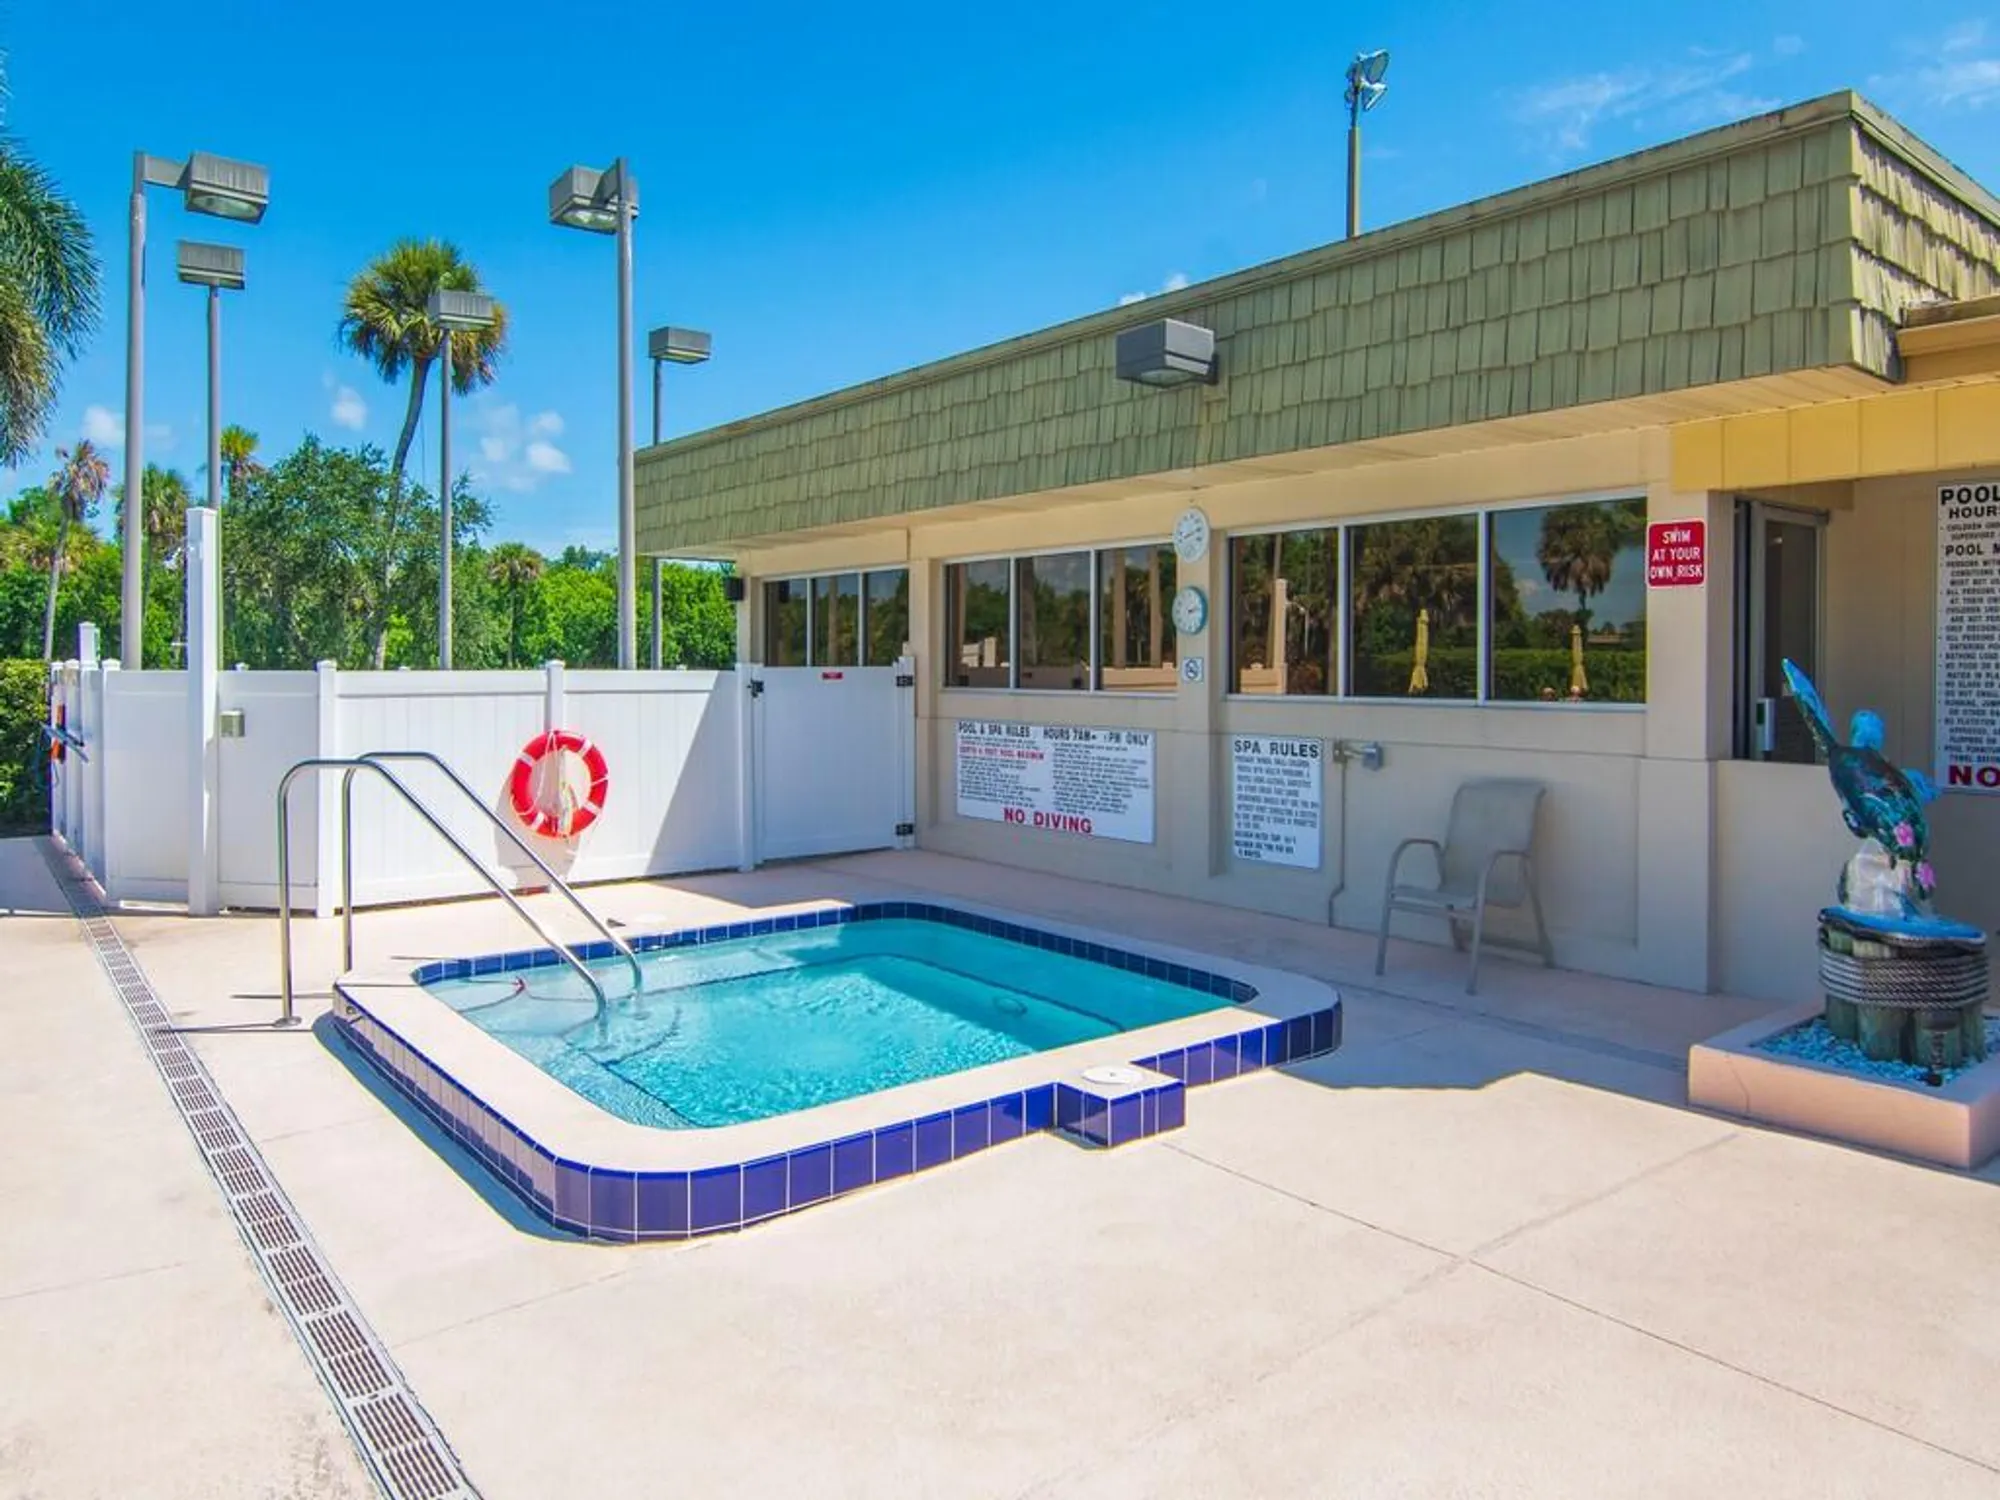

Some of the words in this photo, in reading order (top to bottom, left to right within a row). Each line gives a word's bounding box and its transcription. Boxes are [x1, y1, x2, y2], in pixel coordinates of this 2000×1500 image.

[1941, 485, 2000, 505] POOL
[1949, 506, 2000, 519] HOUR
[1662, 529, 1691, 544] SWIM
[1652, 549, 1666, 562] AT
[1670, 546, 1700, 560] YOUR
[1945, 543, 1984, 556] POOL
[1650, 566, 1673, 579] OWN
[1677, 564, 1703, 578] RISK
[959, 721, 977, 734] POOL
[988, 724, 1002, 736] SPA
[1006, 725, 1030, 738] RULES
[1043, 727, 1070, 740] HOURS
[1125, 731, 1150, 747] ONLY
[1234, 740, 1261, 754] SPA
[1270, 742, 1319, 759] RULES
[1949, 765, 2000, 787] NO
[1004, 807, 1025, 824] NO
[1033, 811, 1092, 834] DIVING
